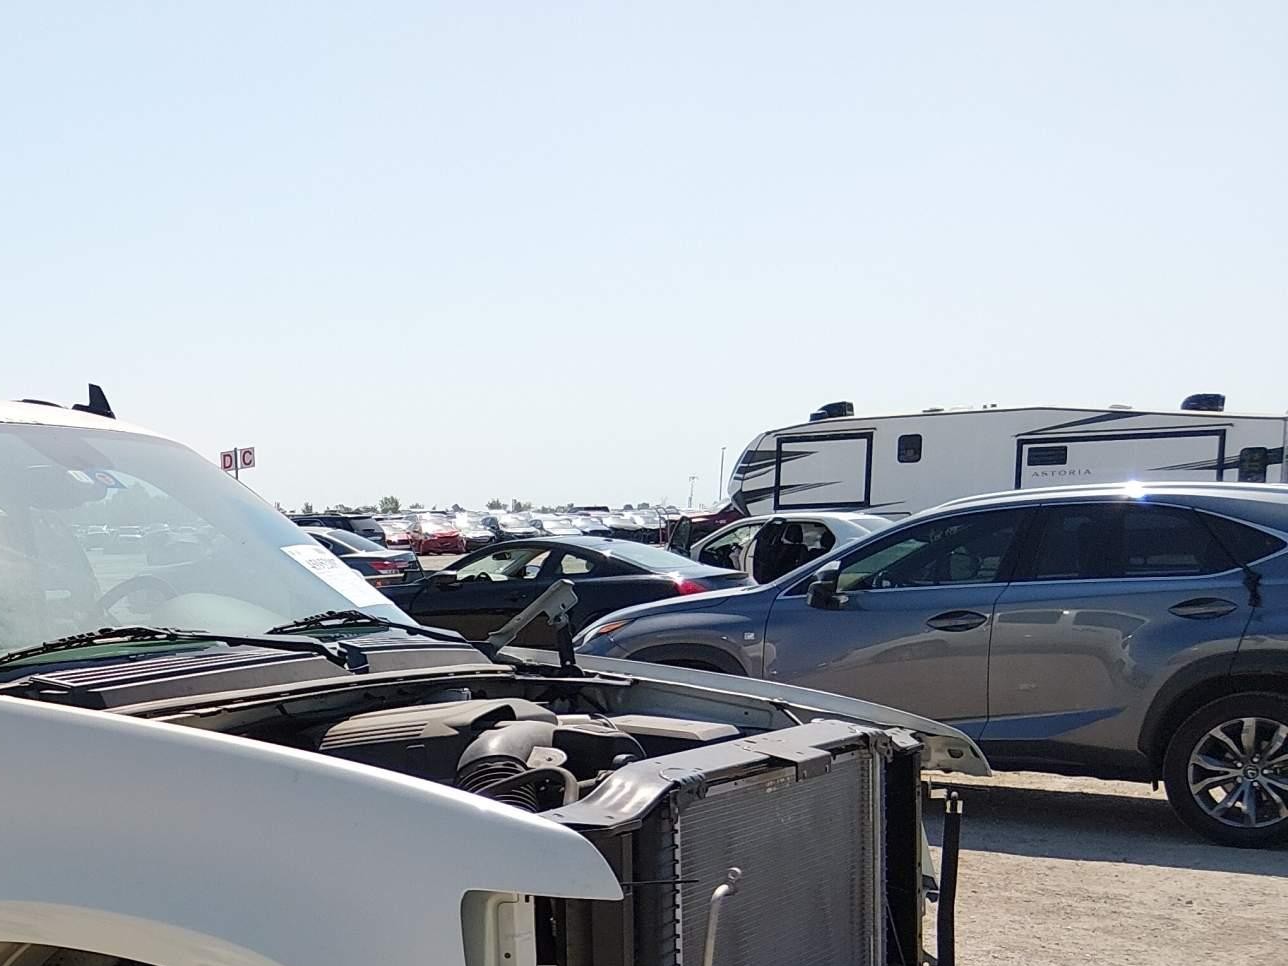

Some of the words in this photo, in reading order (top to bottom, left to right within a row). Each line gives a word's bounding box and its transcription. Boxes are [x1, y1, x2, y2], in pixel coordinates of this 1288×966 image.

[222, 453, 233, 469] D
[242, 449, 253, 466] C
[1031, 468, 1093, 478] ASTORIA
